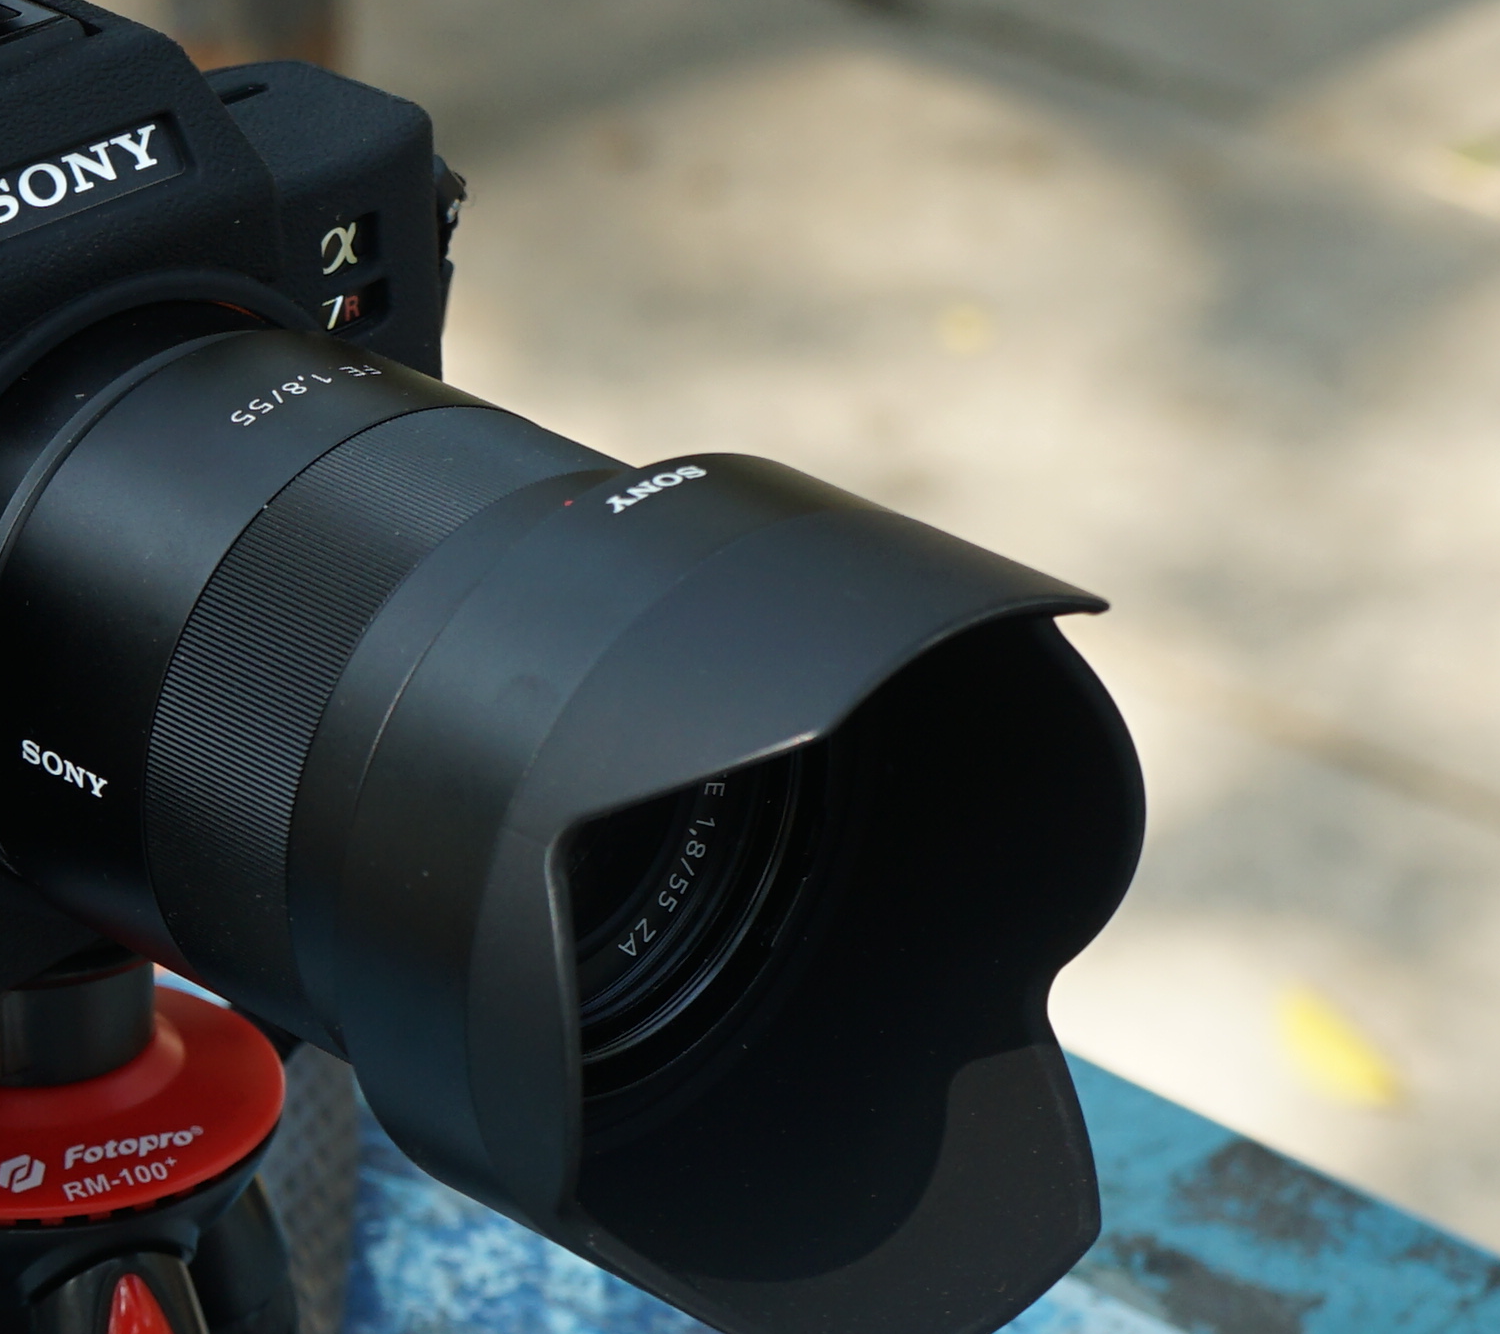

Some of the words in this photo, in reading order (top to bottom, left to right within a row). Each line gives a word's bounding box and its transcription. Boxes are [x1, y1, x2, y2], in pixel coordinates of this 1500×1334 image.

[321, 294, 361, 331] 7R
[604, 464, 708, 515] SONY
[21, 738, 109, 799] SONY
[657, 816, 717, 914] 1,8/55
[617, 917, 658, 958] ZA
